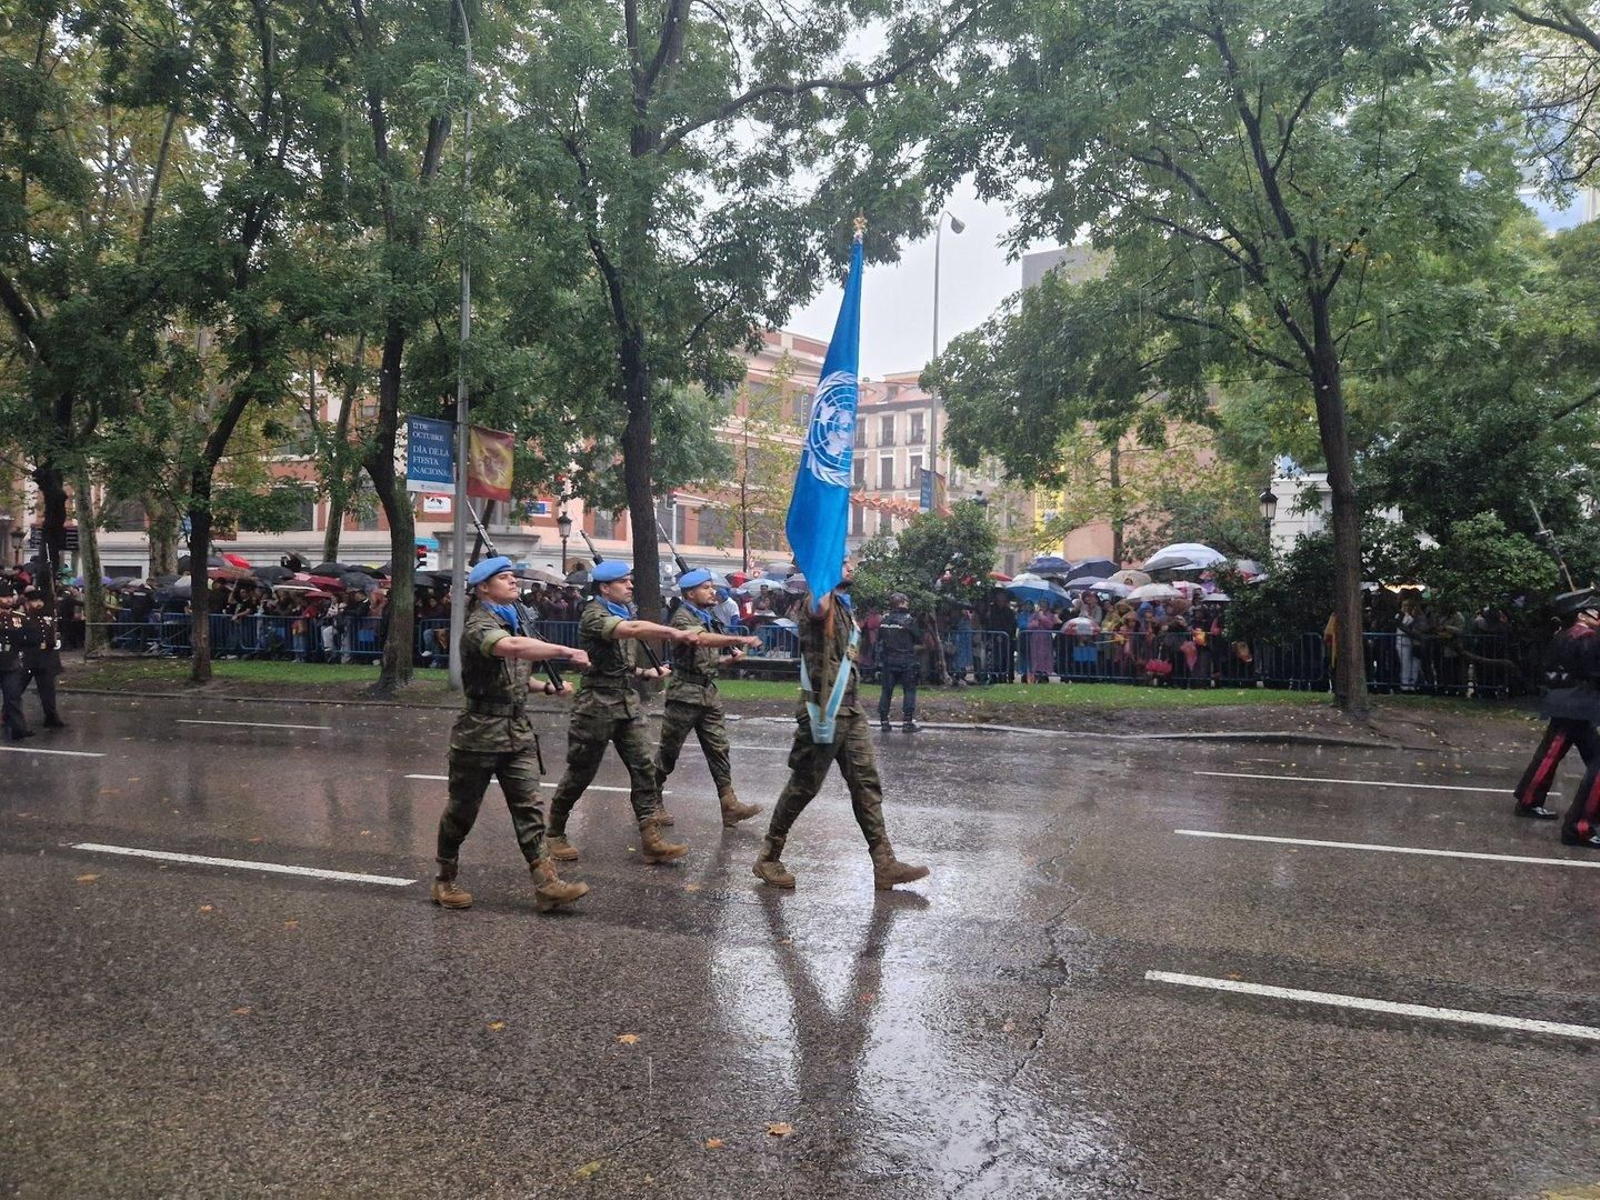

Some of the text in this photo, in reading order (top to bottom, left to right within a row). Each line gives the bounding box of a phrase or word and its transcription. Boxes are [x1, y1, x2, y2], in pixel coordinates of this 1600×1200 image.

[412, 430, 444, 441] OCTUBRE
[413, 445, 450, 457] DÍA DE LA
[413, 455, 439, 465] FIESTA
